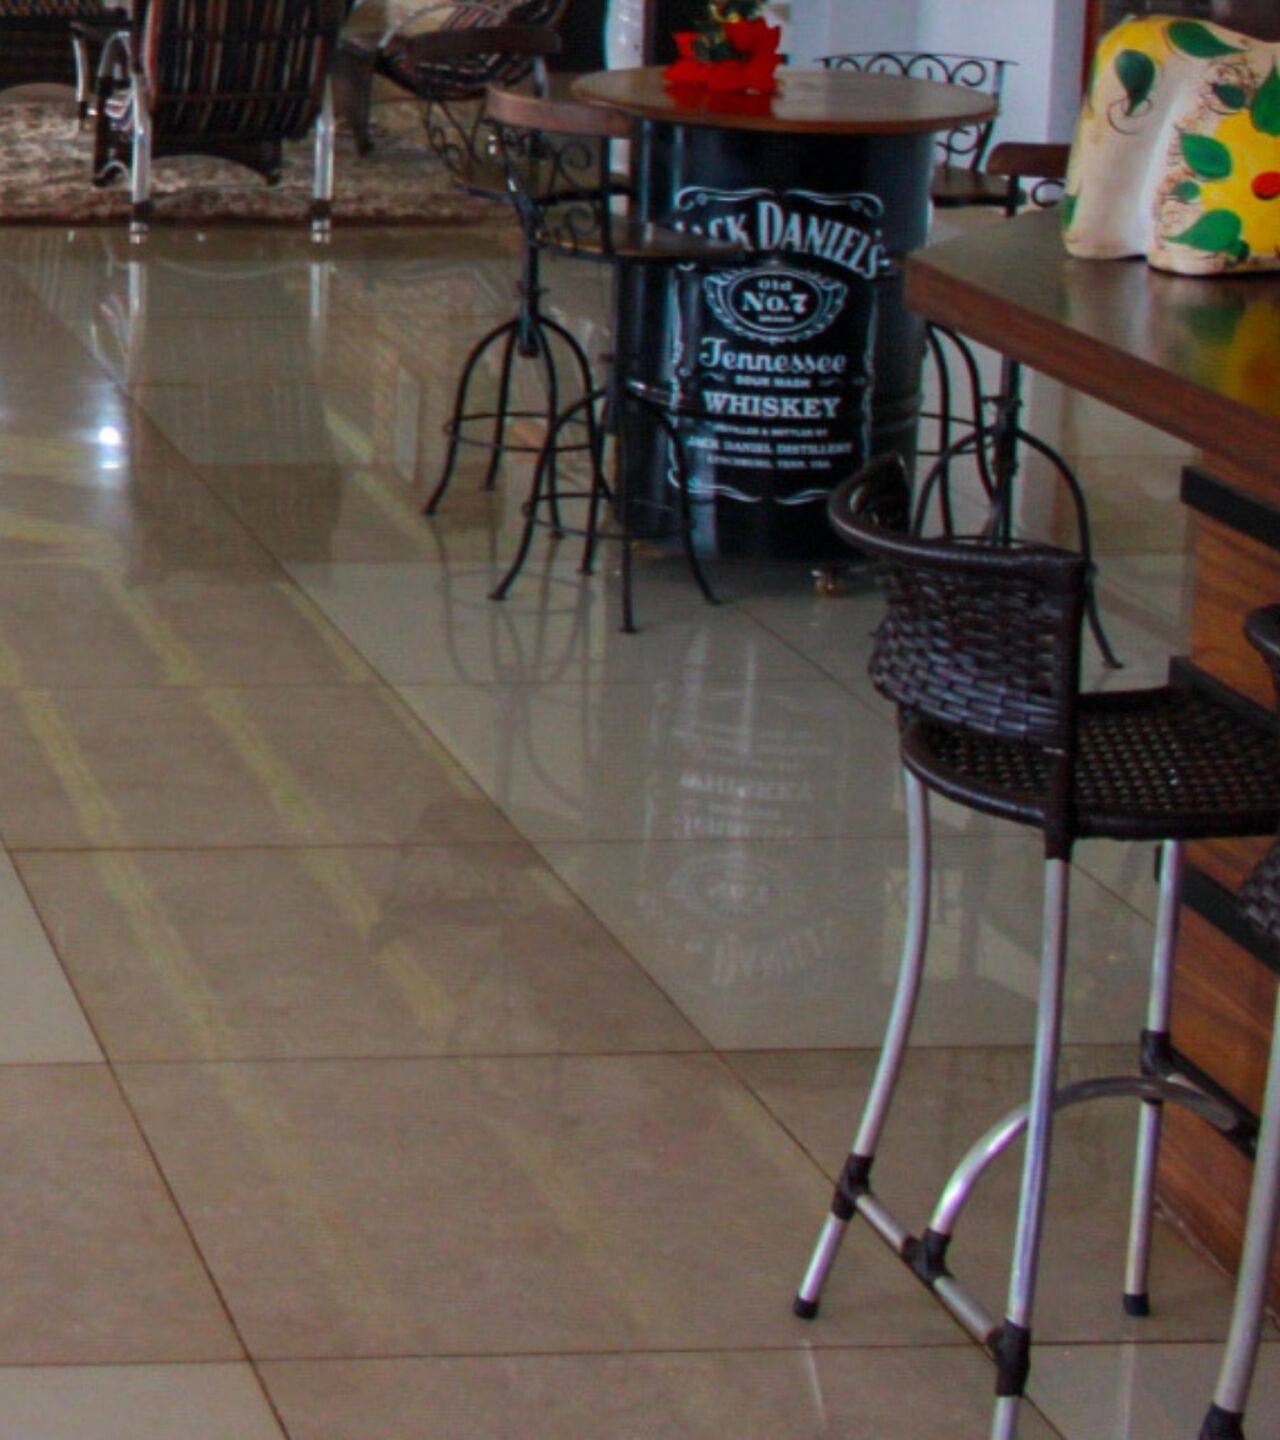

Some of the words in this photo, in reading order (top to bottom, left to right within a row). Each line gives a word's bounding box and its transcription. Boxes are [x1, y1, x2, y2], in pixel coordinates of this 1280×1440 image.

[757, 201, 887, 279] DANIEL'S
[699, 337, 847, 373] Tennessee
[702, 390, 841, 418] WHISKEY
